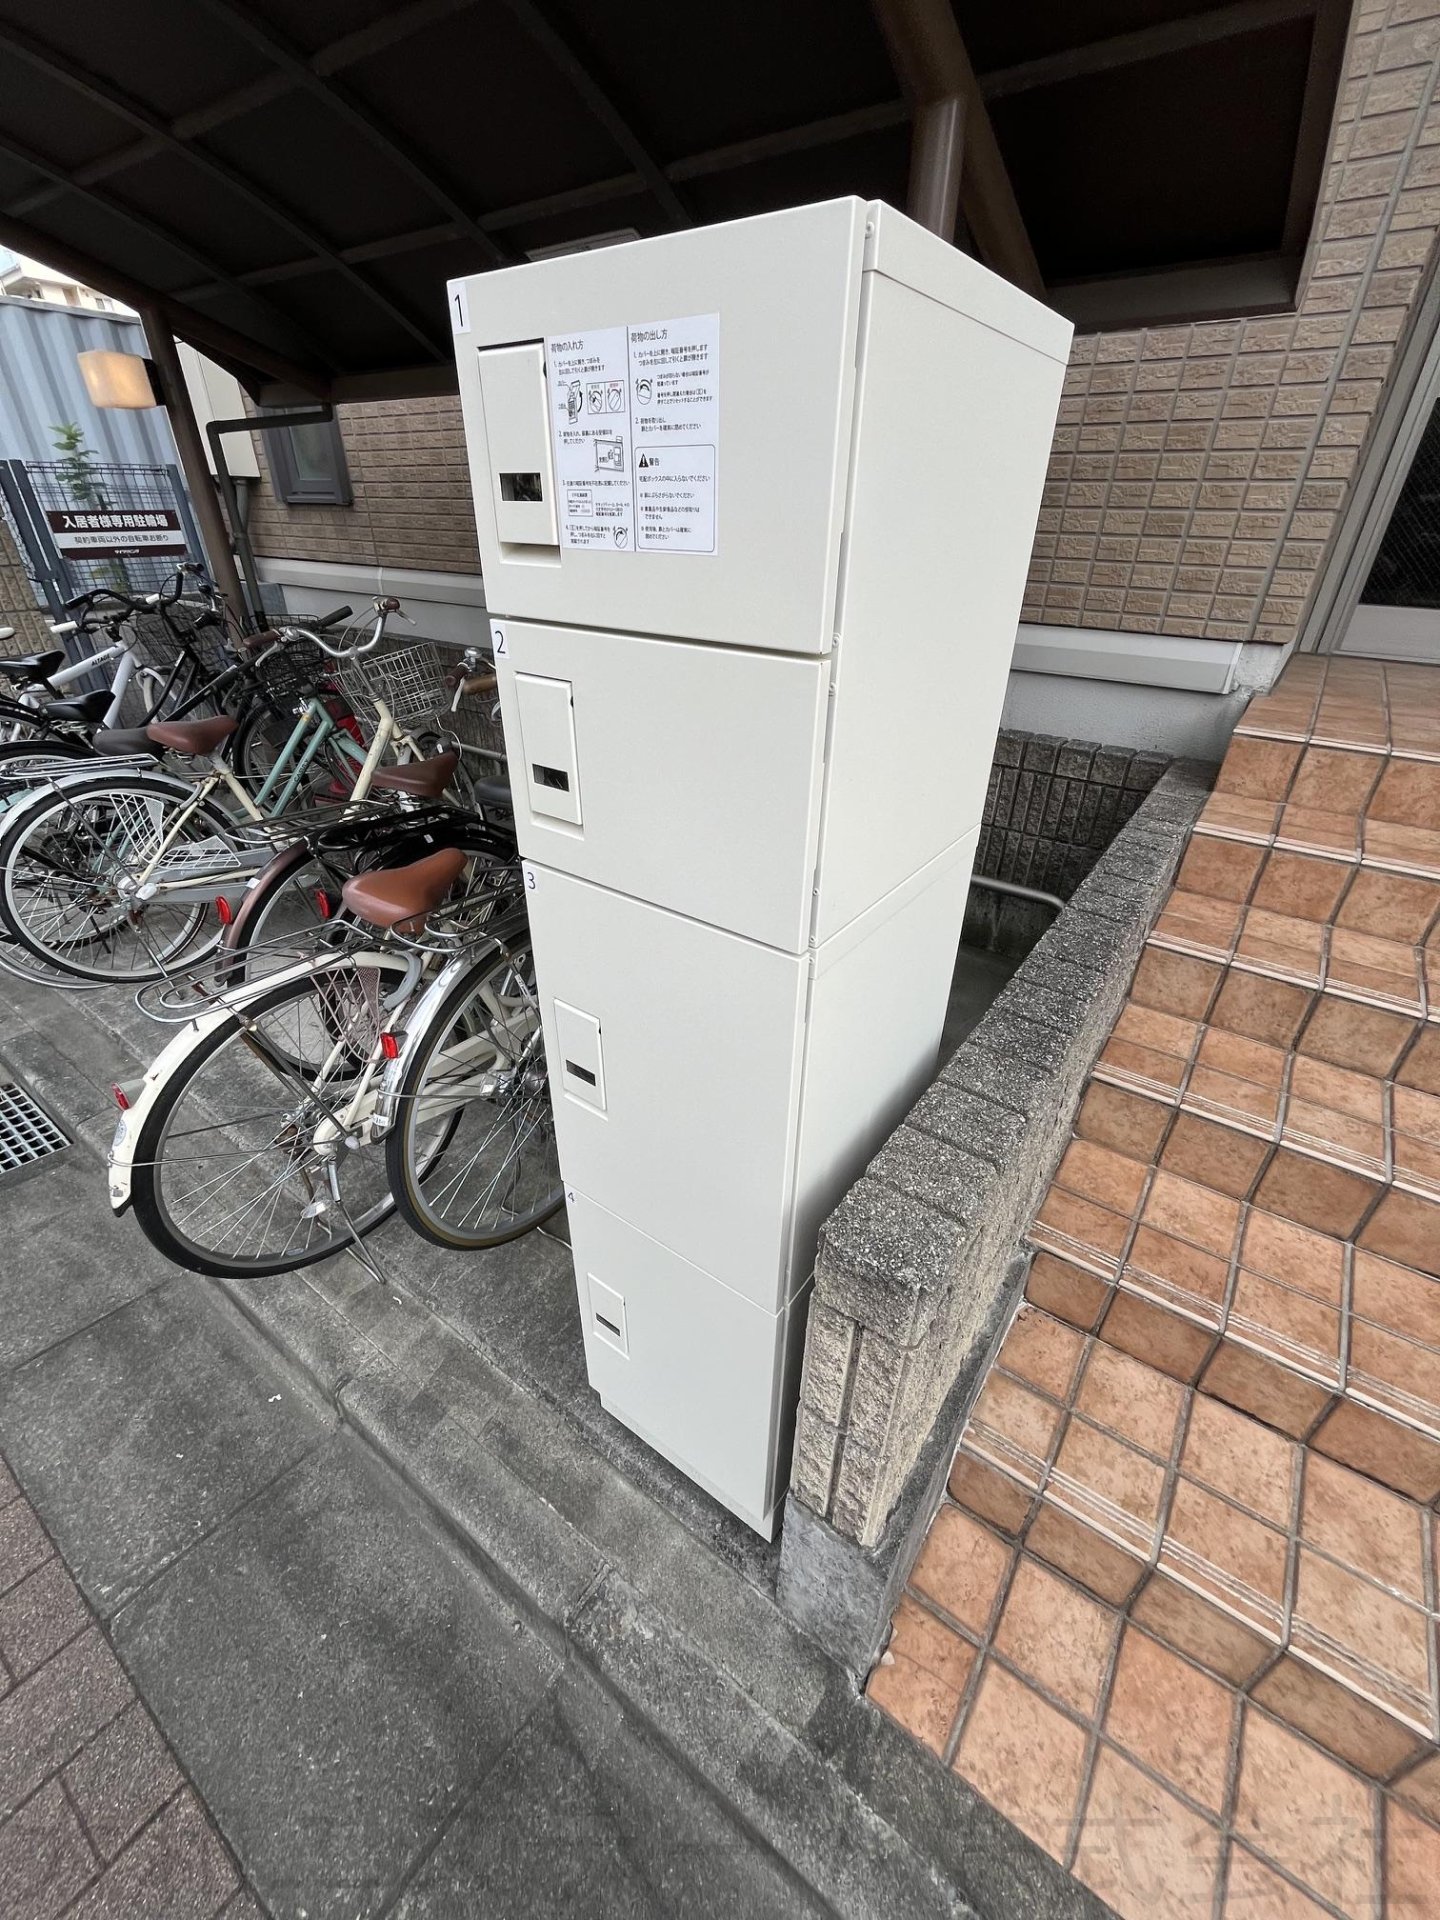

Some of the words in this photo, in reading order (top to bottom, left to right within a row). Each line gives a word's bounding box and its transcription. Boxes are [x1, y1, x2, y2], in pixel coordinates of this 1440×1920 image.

[454, 294, 463, 327] 1
[631, 328, 668, 343] 荷物の出し方
[551, 339, 584, 353] 荷物の入れ方
[649, 457, 660, 466] 警告
[62, 514, 169, 528] 入居者様専用駐輪場
[74, 535, 169, 544] 契約車両以外の自転車お断り
[495, 630, 506, 654] 2
[527, 871, 536, 890] 3
[568, 1192, 575, 1202] 4
